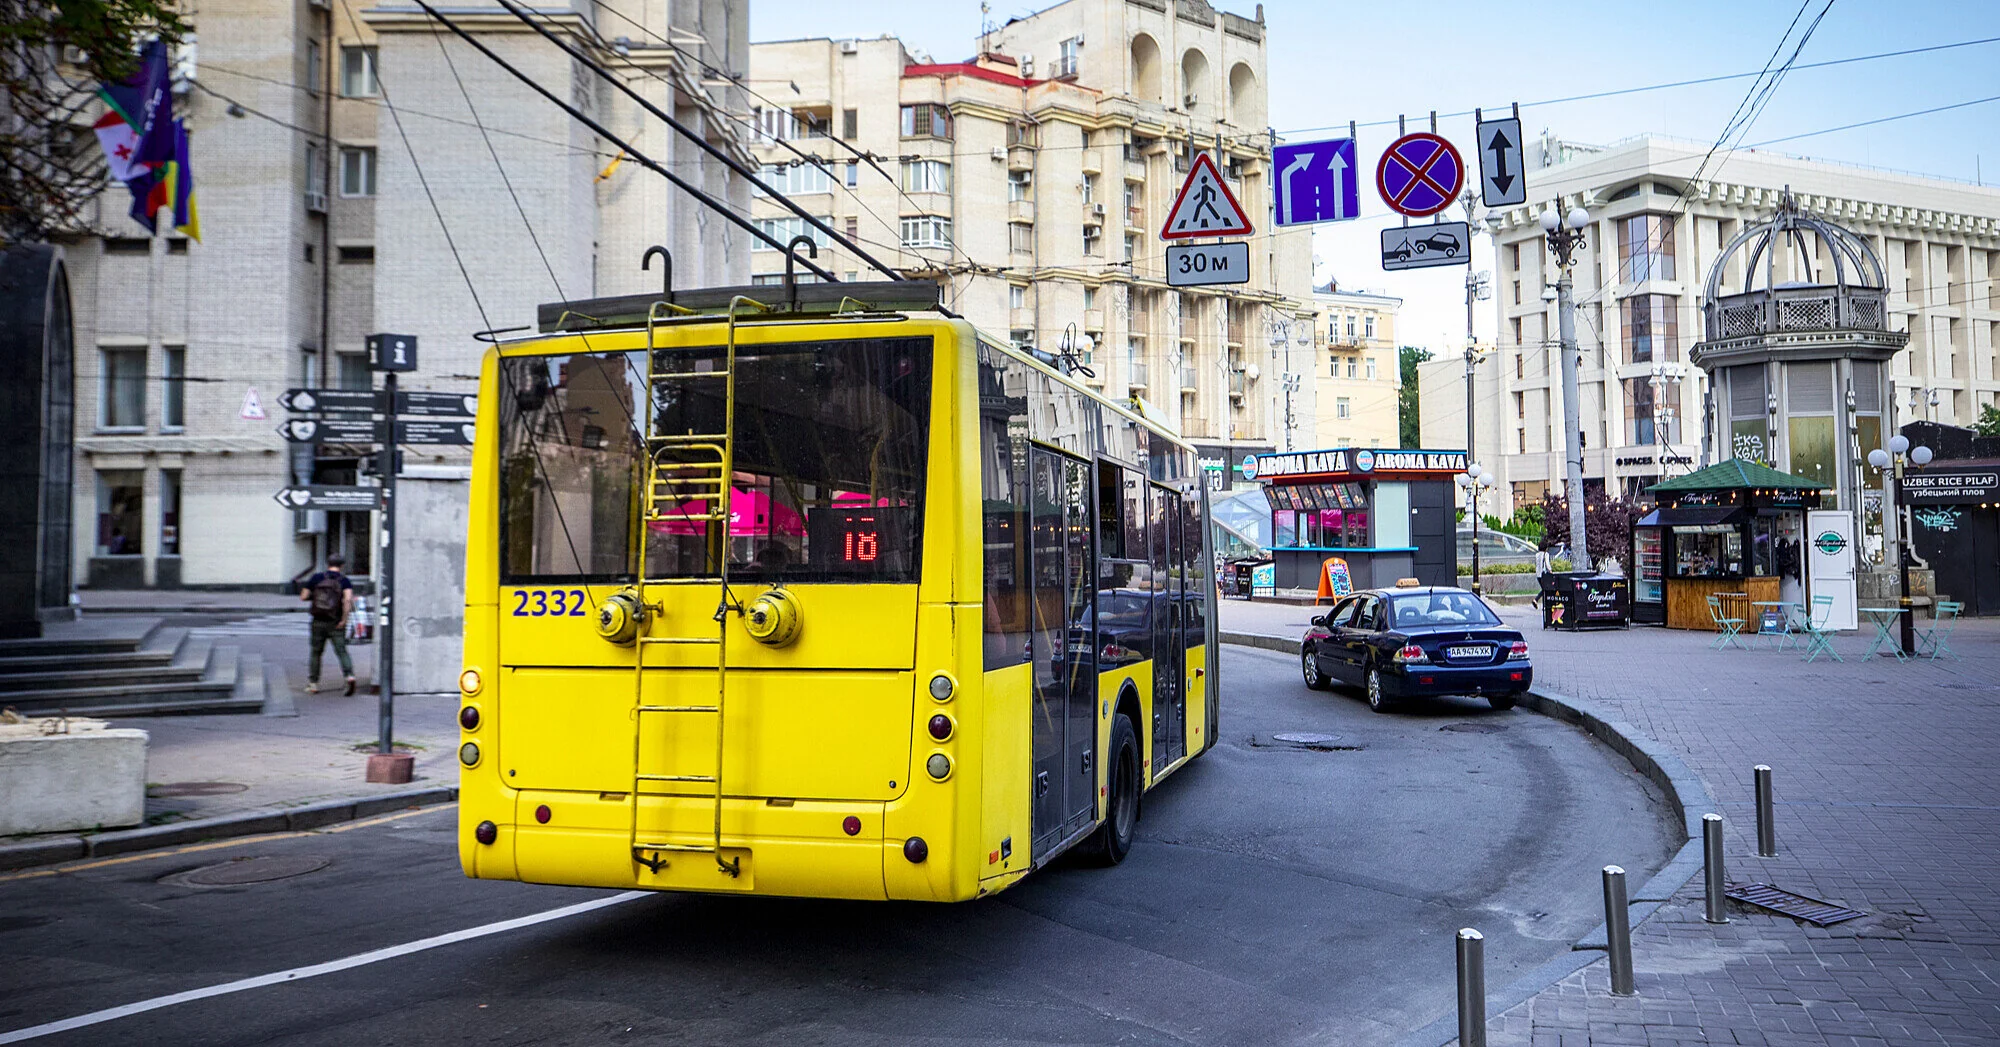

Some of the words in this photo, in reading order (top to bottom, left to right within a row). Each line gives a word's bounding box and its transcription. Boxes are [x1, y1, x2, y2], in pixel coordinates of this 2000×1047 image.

[1179, 253, 1207, 274] 30
[1258, 454, 1305, 476] AROMA
[1307, 451, 1347, 473] KAVA
[1374, 453, 1426, 469] AROMA
[1428, 454, 1466, 469] KAVA
[1902, 478, 1935, 487] UZBEK
[1938, 477, 1962, 486] RICE
[1965, 476, 1994, 485] PILAF
[1913, 488, 1960, 498] узбецький
[513, 589, 586, 617] 2332
[1451, 648, 1462, 656] AA
[1462, 648, 1480, 656] 9474
